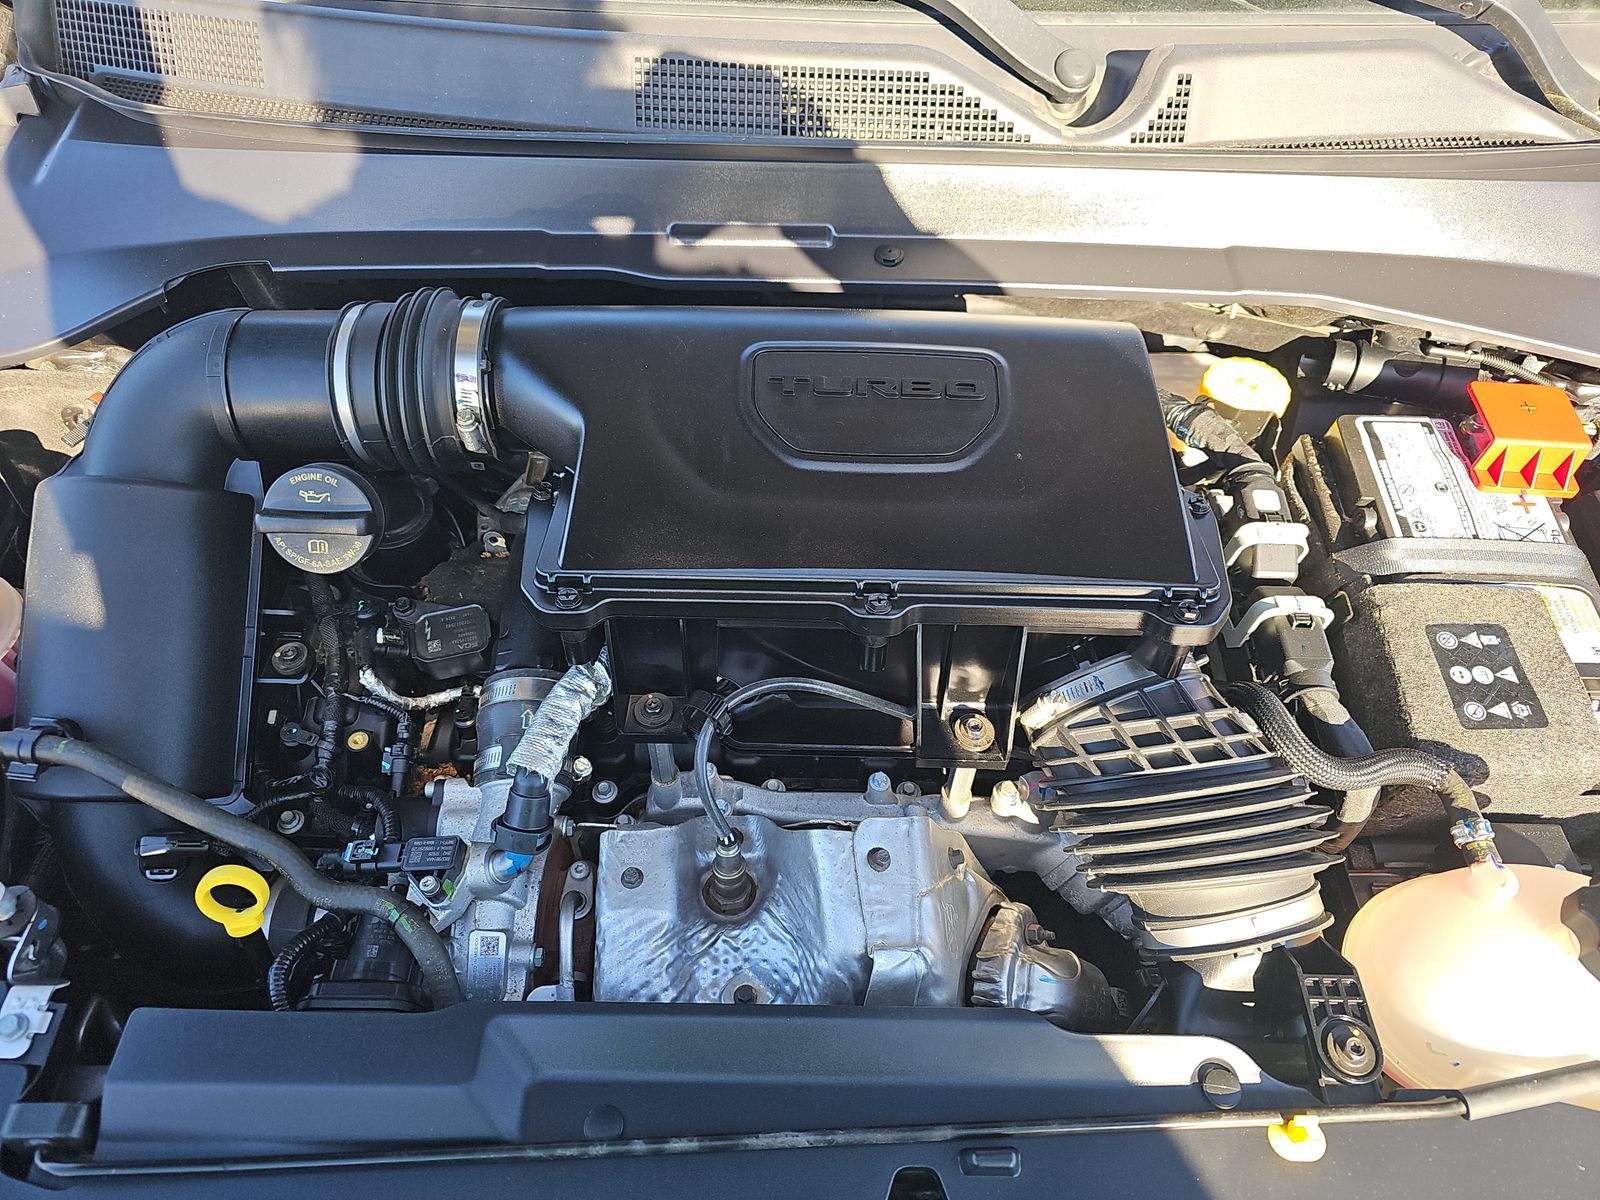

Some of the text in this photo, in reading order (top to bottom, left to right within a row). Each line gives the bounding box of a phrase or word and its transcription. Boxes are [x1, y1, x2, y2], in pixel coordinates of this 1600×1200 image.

[767, 375, 986, 401] TURBO
[289, 473, 338, 488] ENGINE OIL
[273, 536, 288, 551] API
